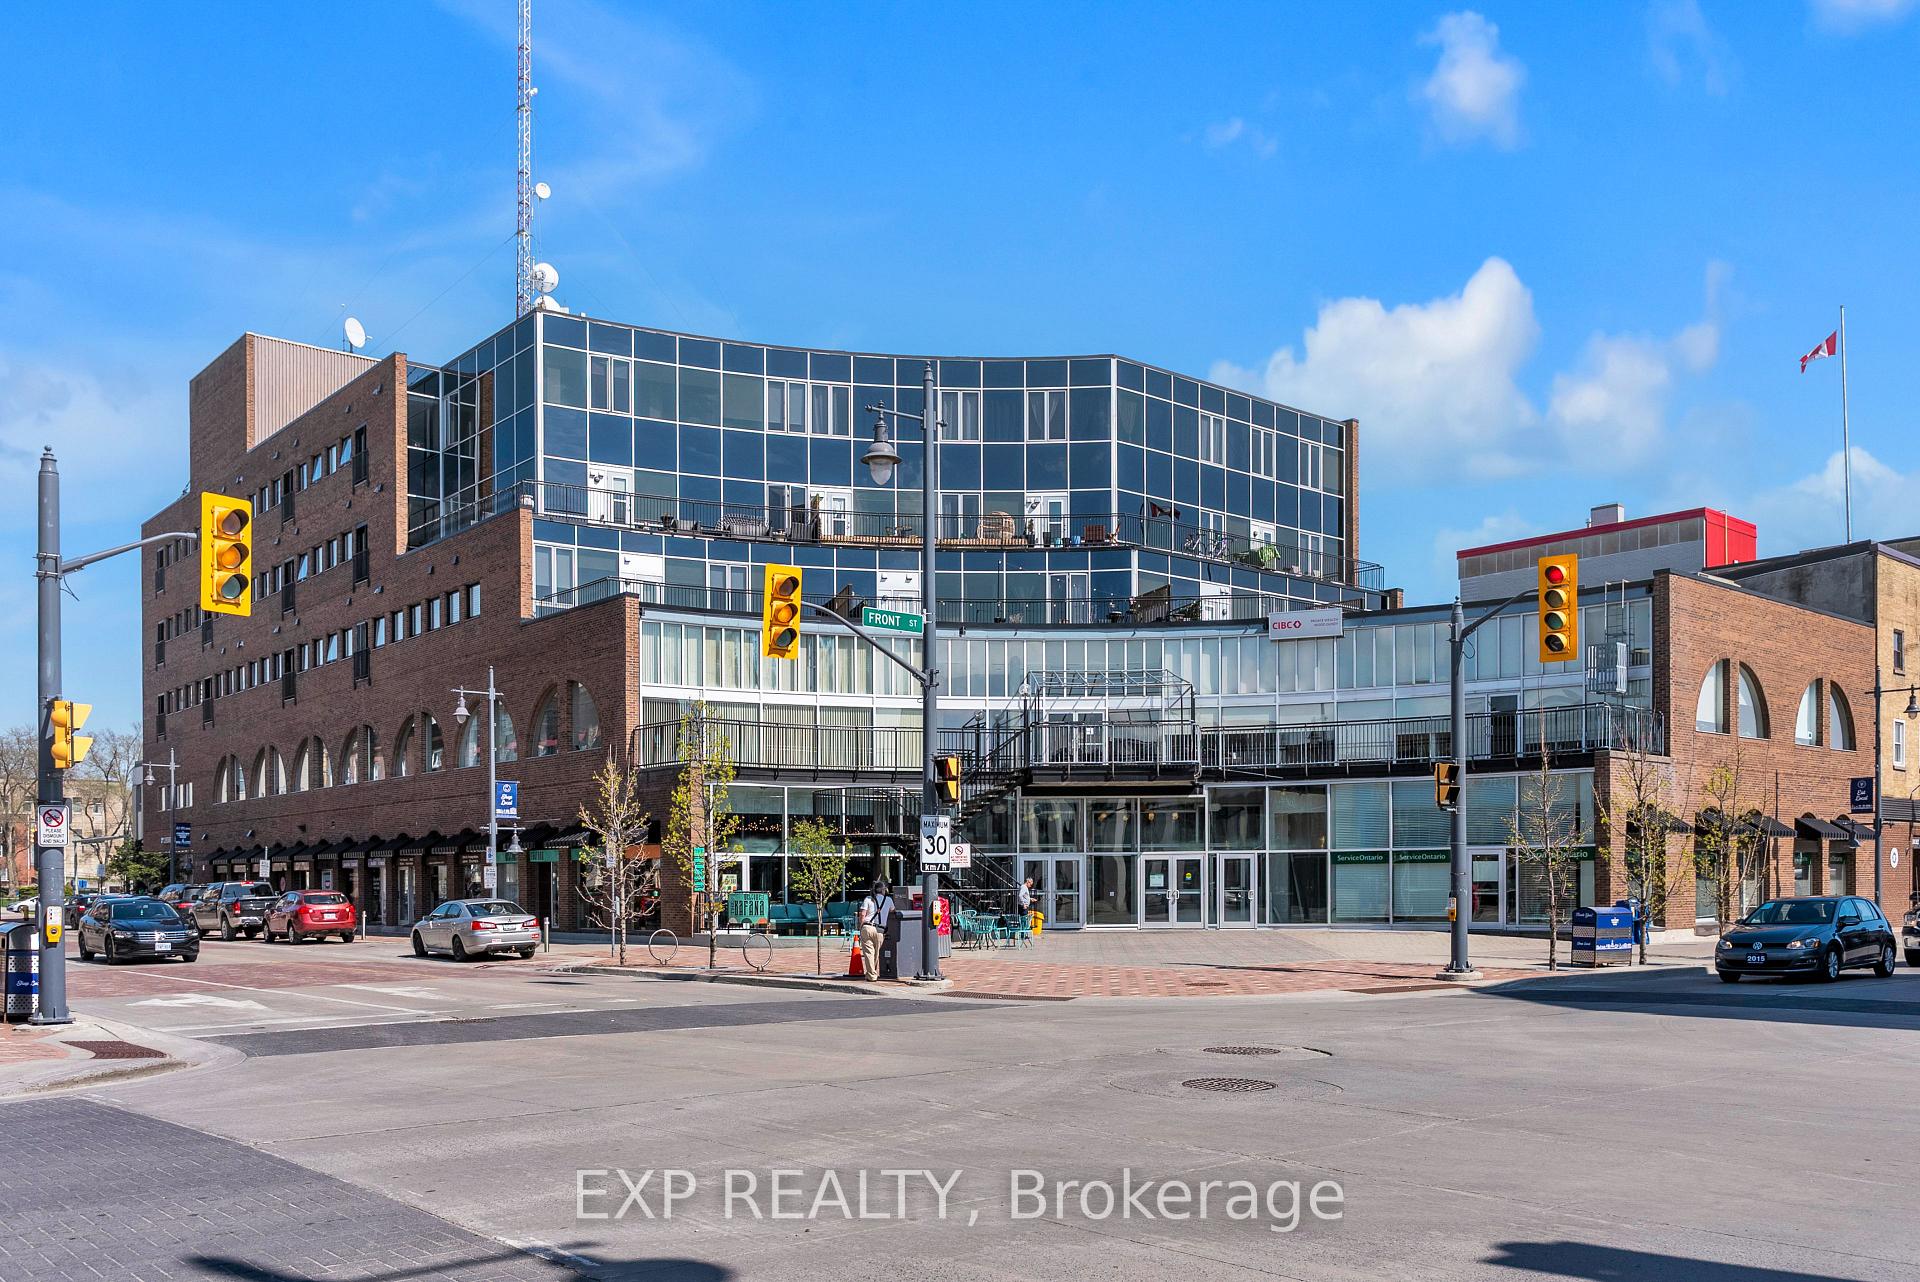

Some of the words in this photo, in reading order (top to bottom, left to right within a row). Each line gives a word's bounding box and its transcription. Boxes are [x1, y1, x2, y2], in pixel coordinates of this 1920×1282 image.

[868, 612, 901, 627] FRONT
[908, 618, 918, 628] ST
[1272, 621, 1293, 630] CIBC
[923, 820, 949, 829] MAXIMUM
[924, 835, 947, 855] 30
[924, 863, 947, 871] km/h
